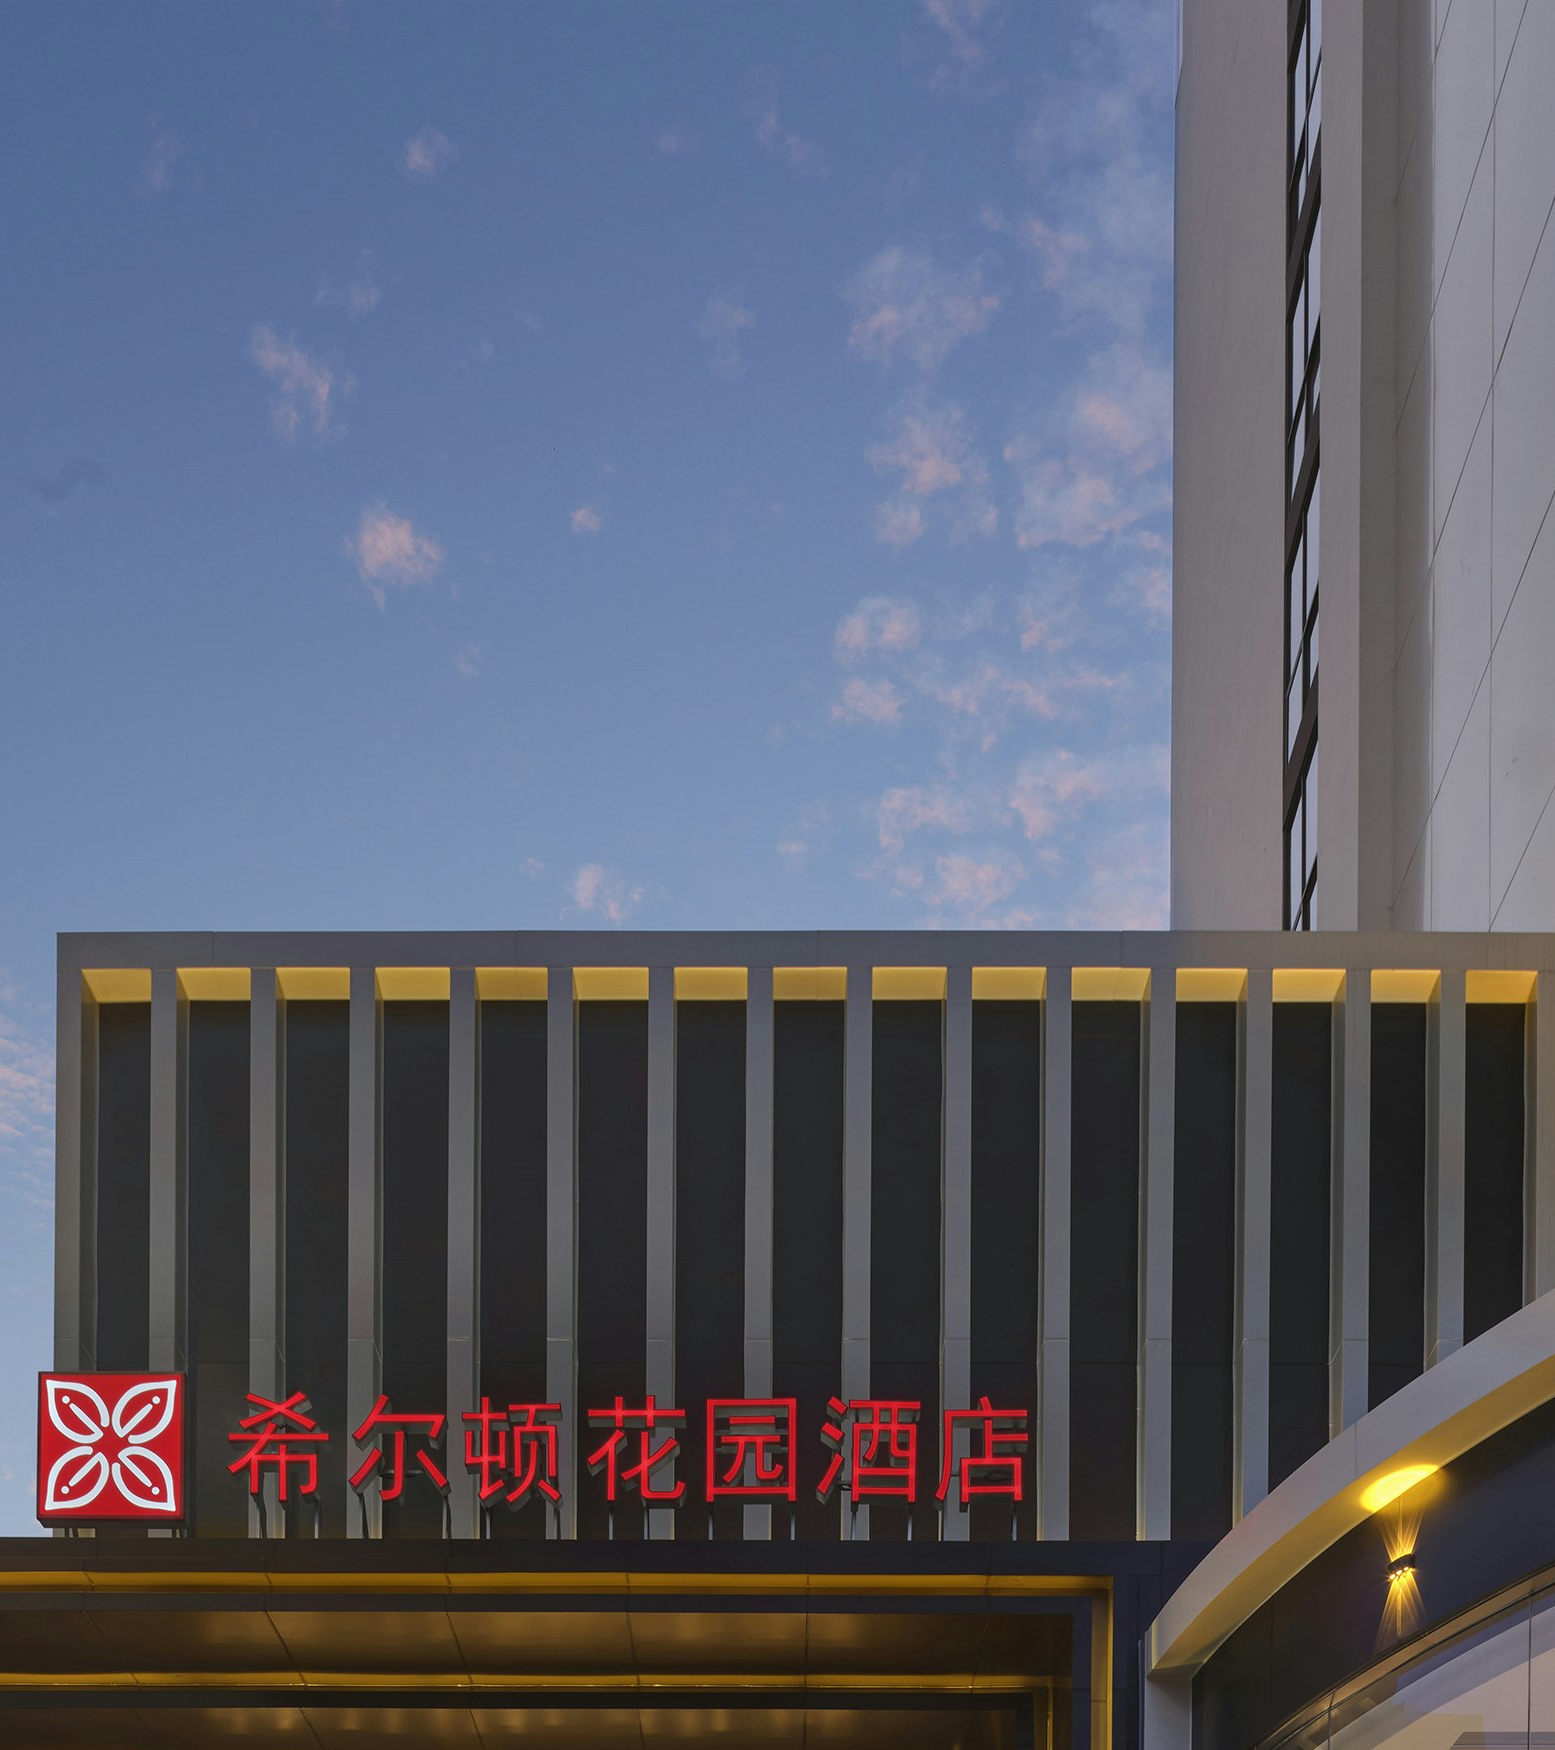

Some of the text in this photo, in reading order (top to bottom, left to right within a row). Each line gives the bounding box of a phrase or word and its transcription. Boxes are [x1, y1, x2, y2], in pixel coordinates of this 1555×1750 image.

[227, 1391, 1029, 1503] 希尔顿花园酒店
